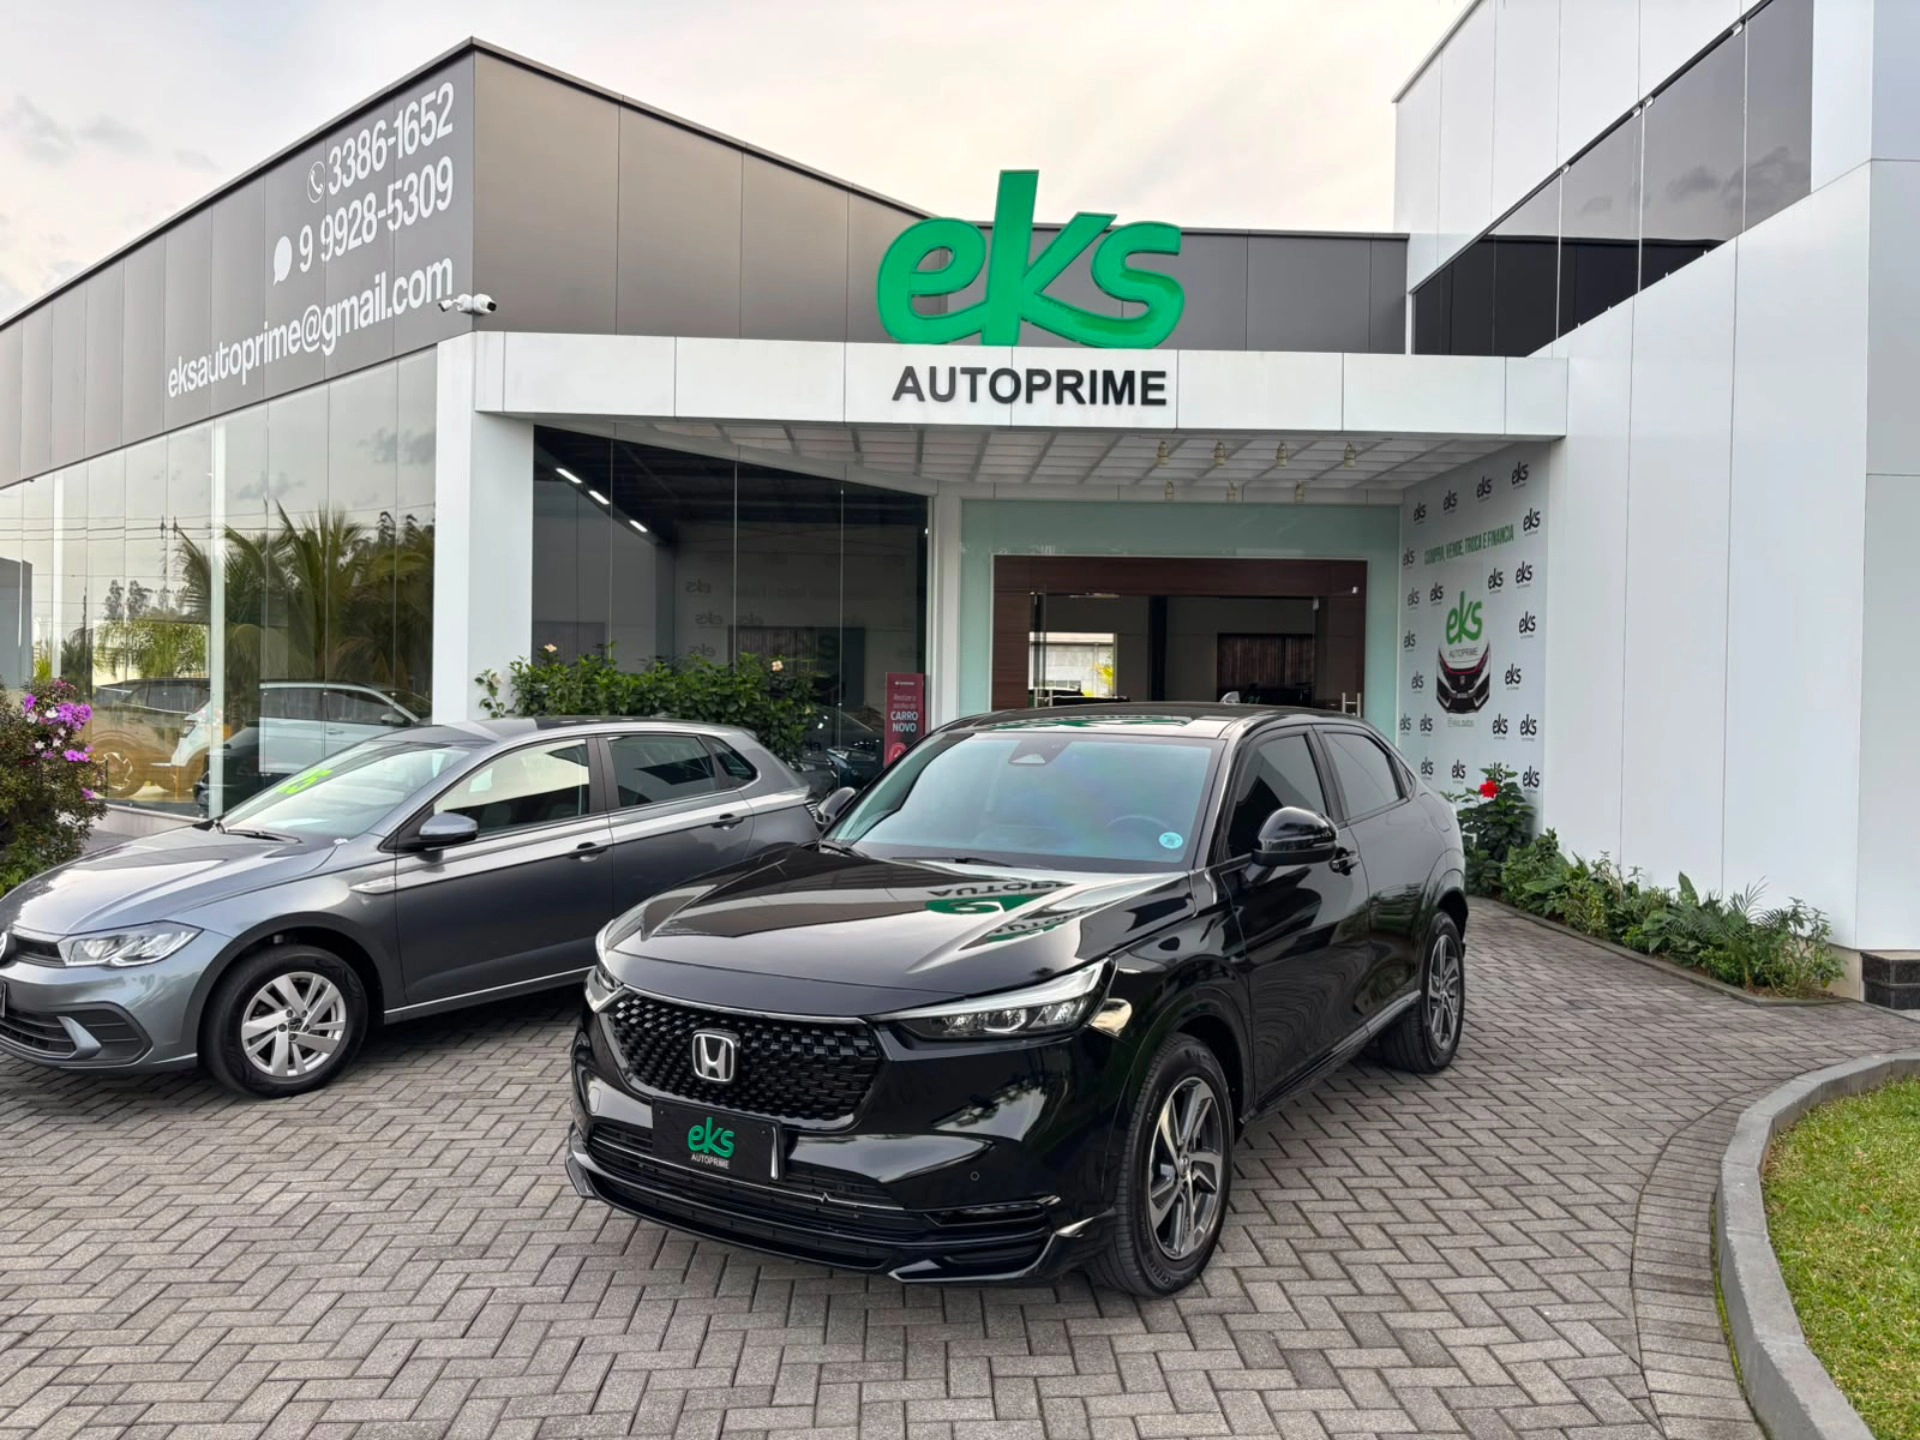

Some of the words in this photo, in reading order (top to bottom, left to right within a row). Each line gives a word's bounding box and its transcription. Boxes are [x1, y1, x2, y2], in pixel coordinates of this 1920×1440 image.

[328, 82, 454, 196] 3386-1652
[299, 225, 313, 273] 9
[320, 155, 453, 263] 9928-5309
[877, 169, 1185, 350] eks
[168, 257, 453, 398] eksautoprime@gmail.com
[891, 366, 1167, 406] AUTOPRIME
[1512, 462, 1529, 485] eks
[1477, 476, 1492, 498] eks
[1414, 502, 1427, 521] eks
[1444, 490, 1457, 511] eks
[1524, 508, 1541, 532] eks
[1488, 568, 1504, 590] eks
[1516, 561, 1533, 584] eks
[1431, 582, 1444, 602] eks
[1446, 590, 1483, 646] eks
[1519, 611, 1536, 634] eks
[1411, 670, 1424, 690] eks
[1505, 663, 1522, 685] eks
[890, 711, 918, 721] CARRO
[892, 722, 917, 732] NOVO
[1420, 713, 1433, 732] eks
[1492, 713, 1508, 735] eks
[1520, 713, 1537, 736] eks
[1421, 756, 1434, 776] eks
[1452, 759, 1466, 780] eks
[1523, 765, 1540, 788] eks
[687, 1116, 735, 1158] eks
[691, 1153, 730, 1170] AUTOPRIME
